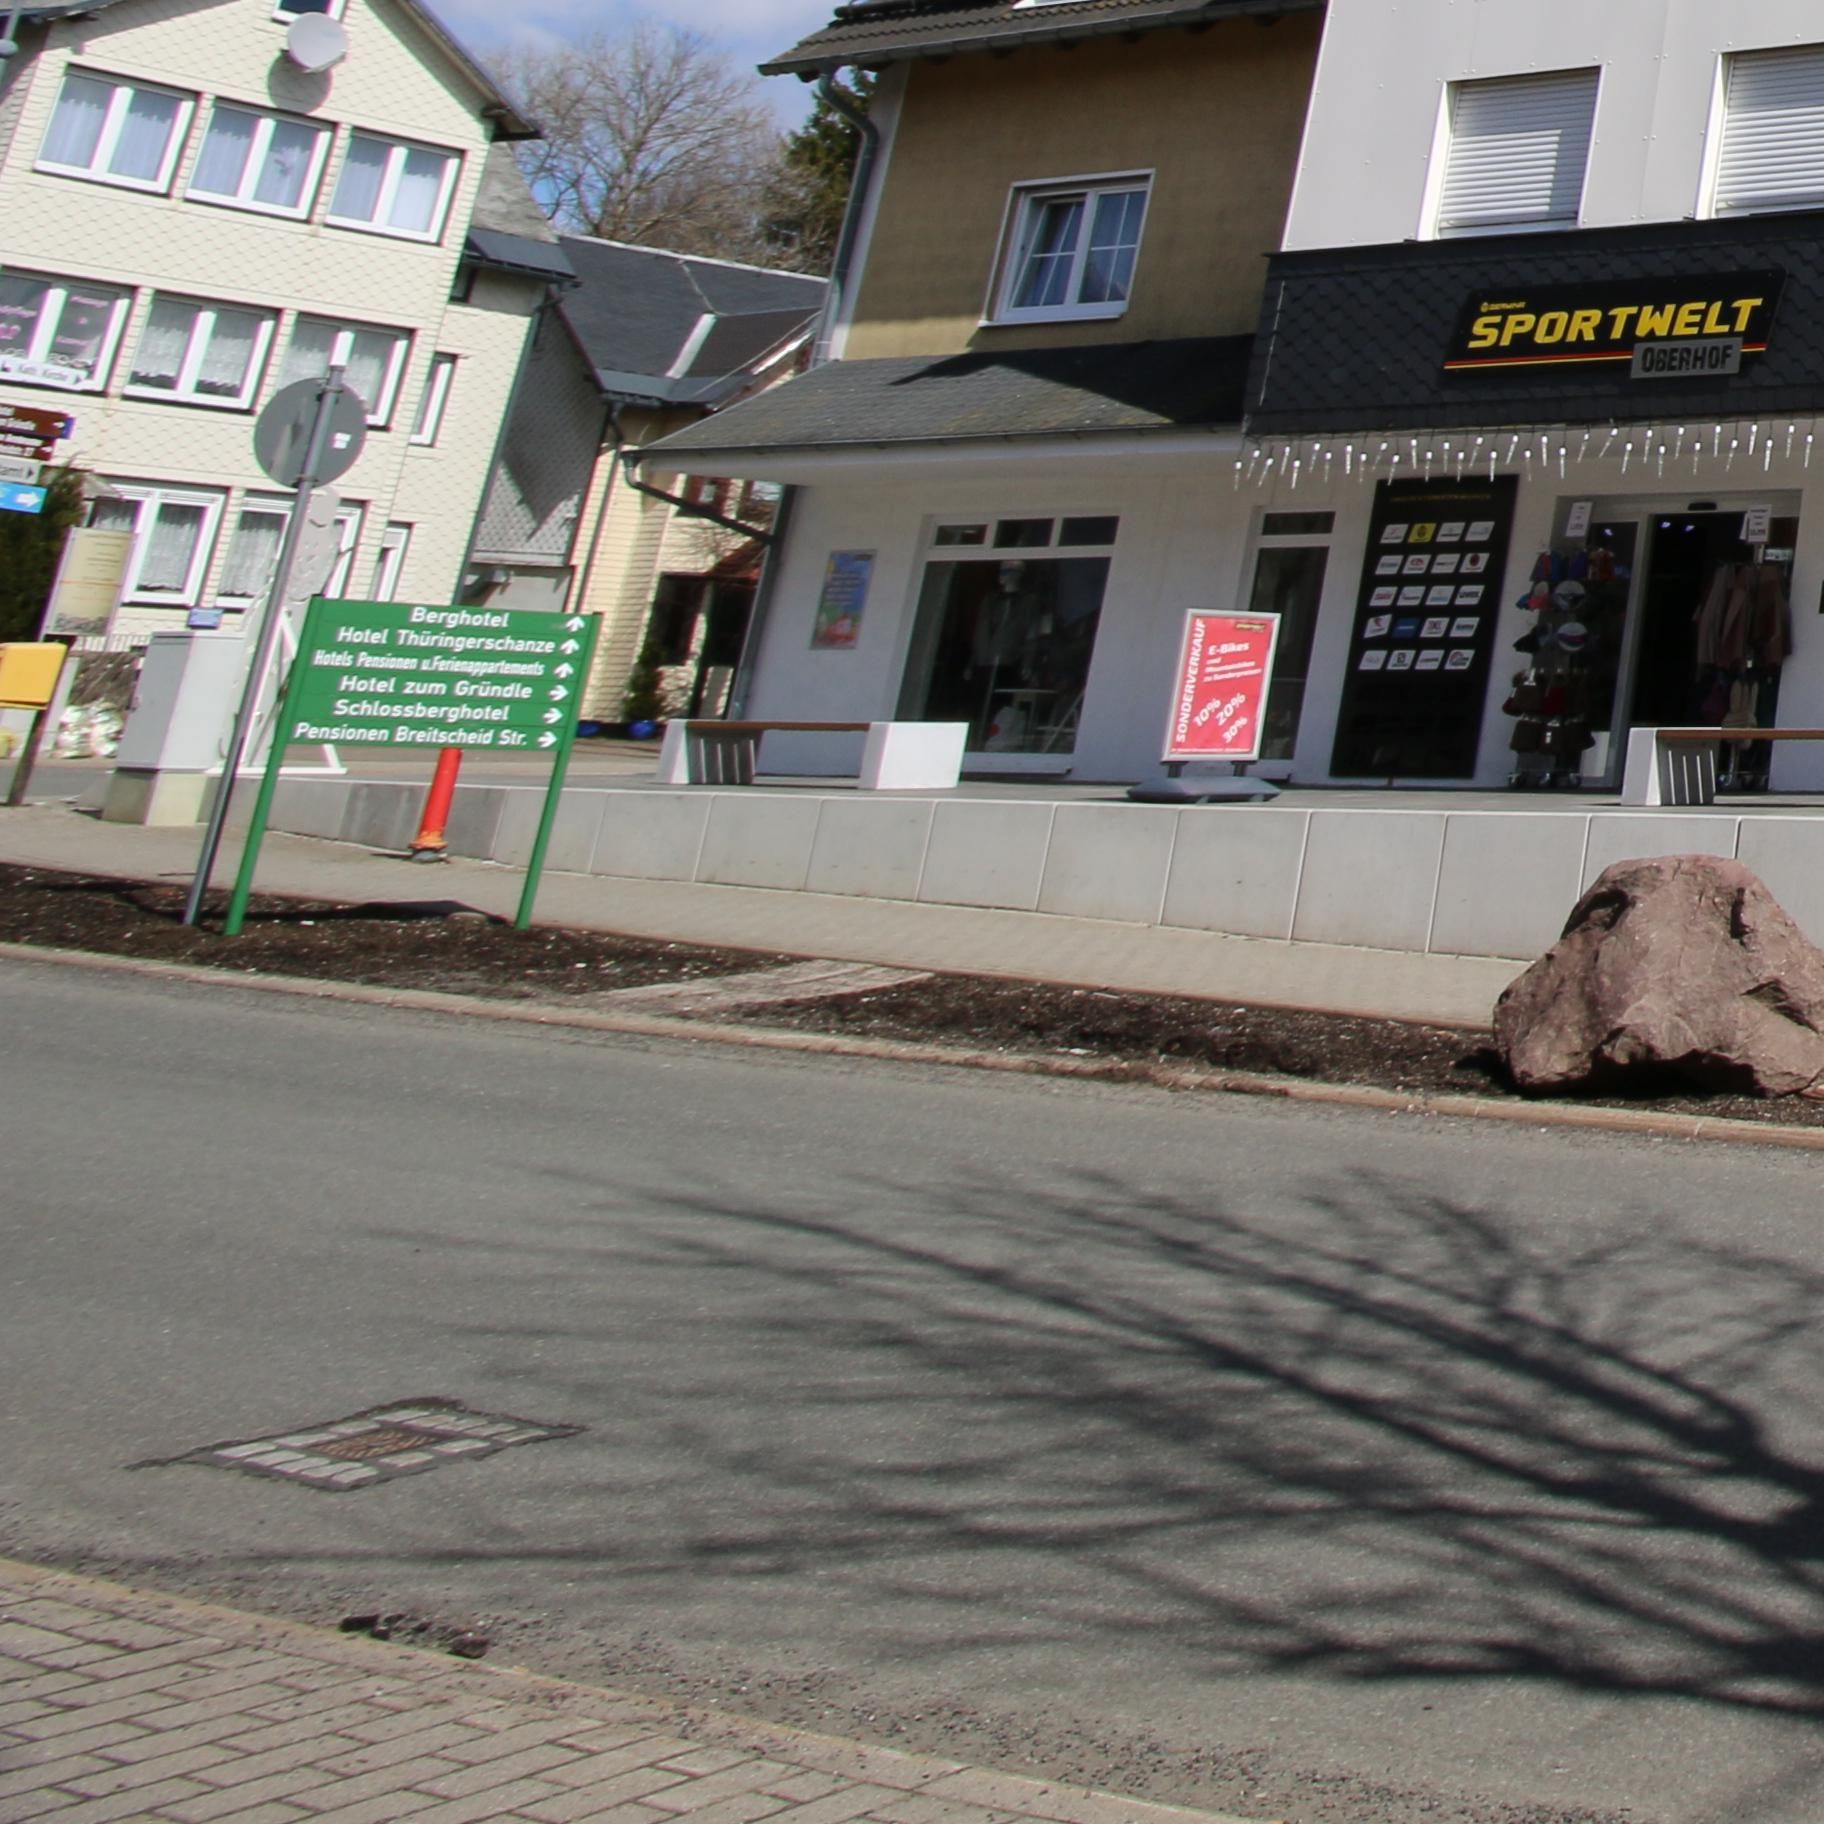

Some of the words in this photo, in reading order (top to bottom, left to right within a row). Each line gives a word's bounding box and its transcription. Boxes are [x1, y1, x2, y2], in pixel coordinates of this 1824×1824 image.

[1467, 297, 1764, 349] SPORTWELT
[1641, 344, 1734, 374] OBERHOF
[411, 606, 509, 628] Berghotel
[336, 626, 388, 644] Hotel
[397, 628, 556, 654] Thüringerschanze
[1208, 642, 1250, 655] E-Bikes
[314, 649, 353, 667] Hotels
[356, 651, 417, 671] Pensionen
[339, 675, 396, 693] Hotel
[402, 680, 447, 696] zum
[454, 678, 533, 700] Gründle
[1176, 617, 1206, 743] SONDERVERKAUF
[332, 699, 510, 723] Schlossberghotel
[1193, 698, 1222, 727] 10%
[1215, 692, 1247, 725] 20%
[294, 722, 389, 742] Pensionen
[393, 725, 494, 745] Breitscheid
[498, 729, 528, 746] Str.
[1222, 716, 1248, 743] 30%
